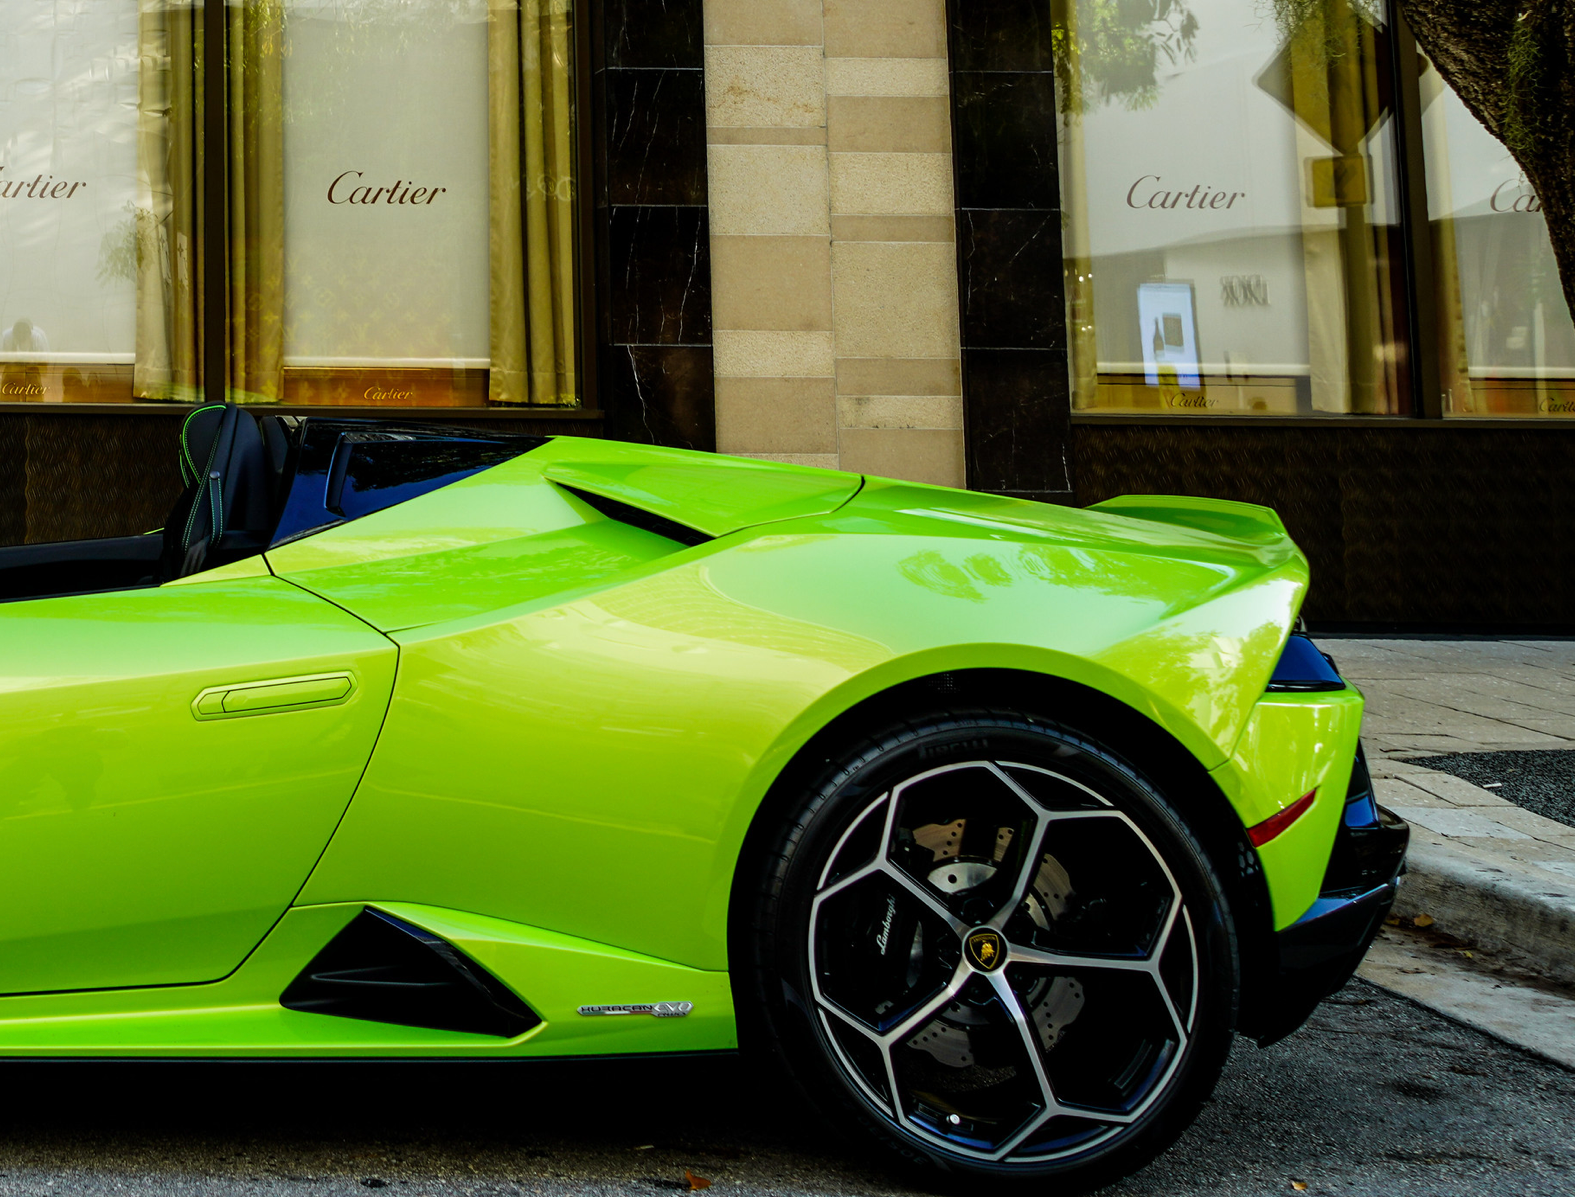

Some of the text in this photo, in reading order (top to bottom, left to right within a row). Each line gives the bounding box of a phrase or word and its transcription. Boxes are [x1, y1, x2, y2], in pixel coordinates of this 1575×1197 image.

[326, 170, 446, 206] Cartier
[1125, 174, 1246, 210] Cartier
[1, 380, 51, 398] Cartier
[363, 385, 413, 402] Cartier
[1170, 392, 1219, 408] Cartier
